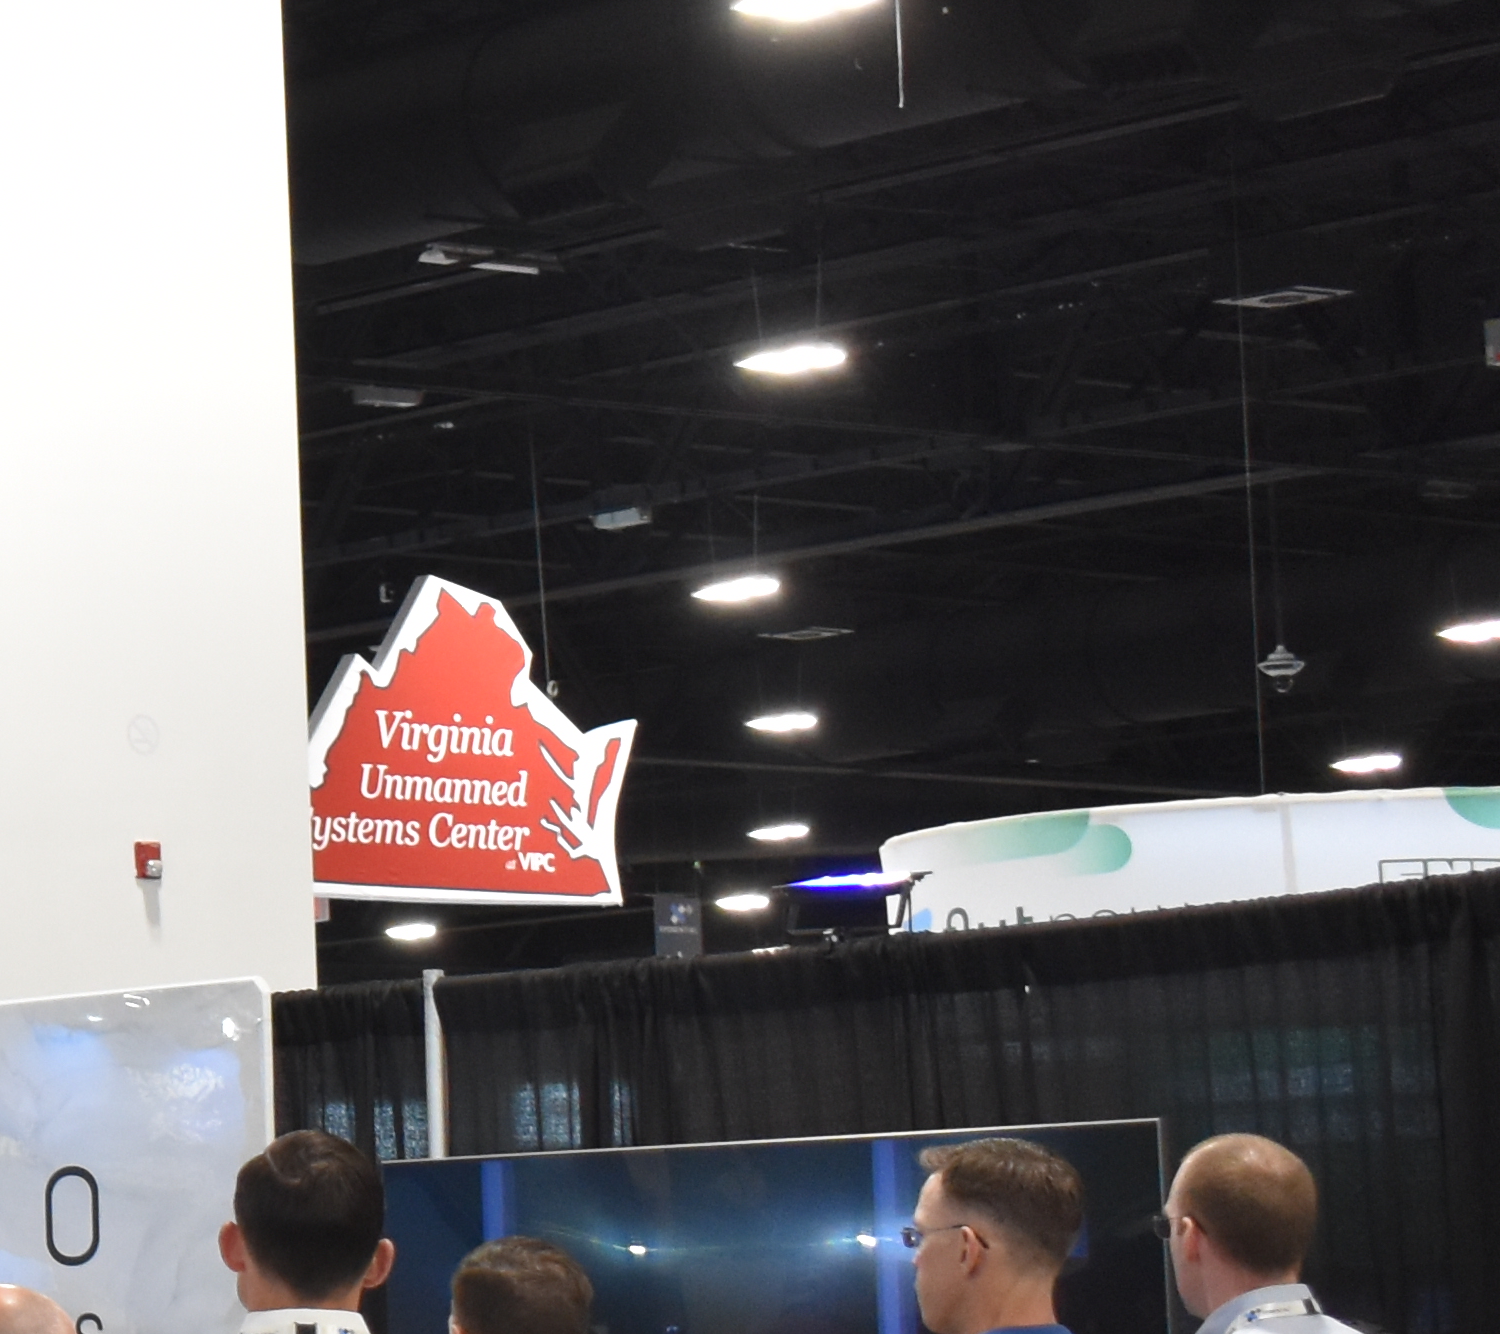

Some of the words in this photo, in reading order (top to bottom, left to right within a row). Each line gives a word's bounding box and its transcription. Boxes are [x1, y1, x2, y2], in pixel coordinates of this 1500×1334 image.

[374, 709, 515, 763] Virginia
[359, 762, 528, 808] Unmanned
[310, 809, 421, 852] ystems
[428, 812, 531, 852] Center
[517, 851, 556, 873] VIPC
